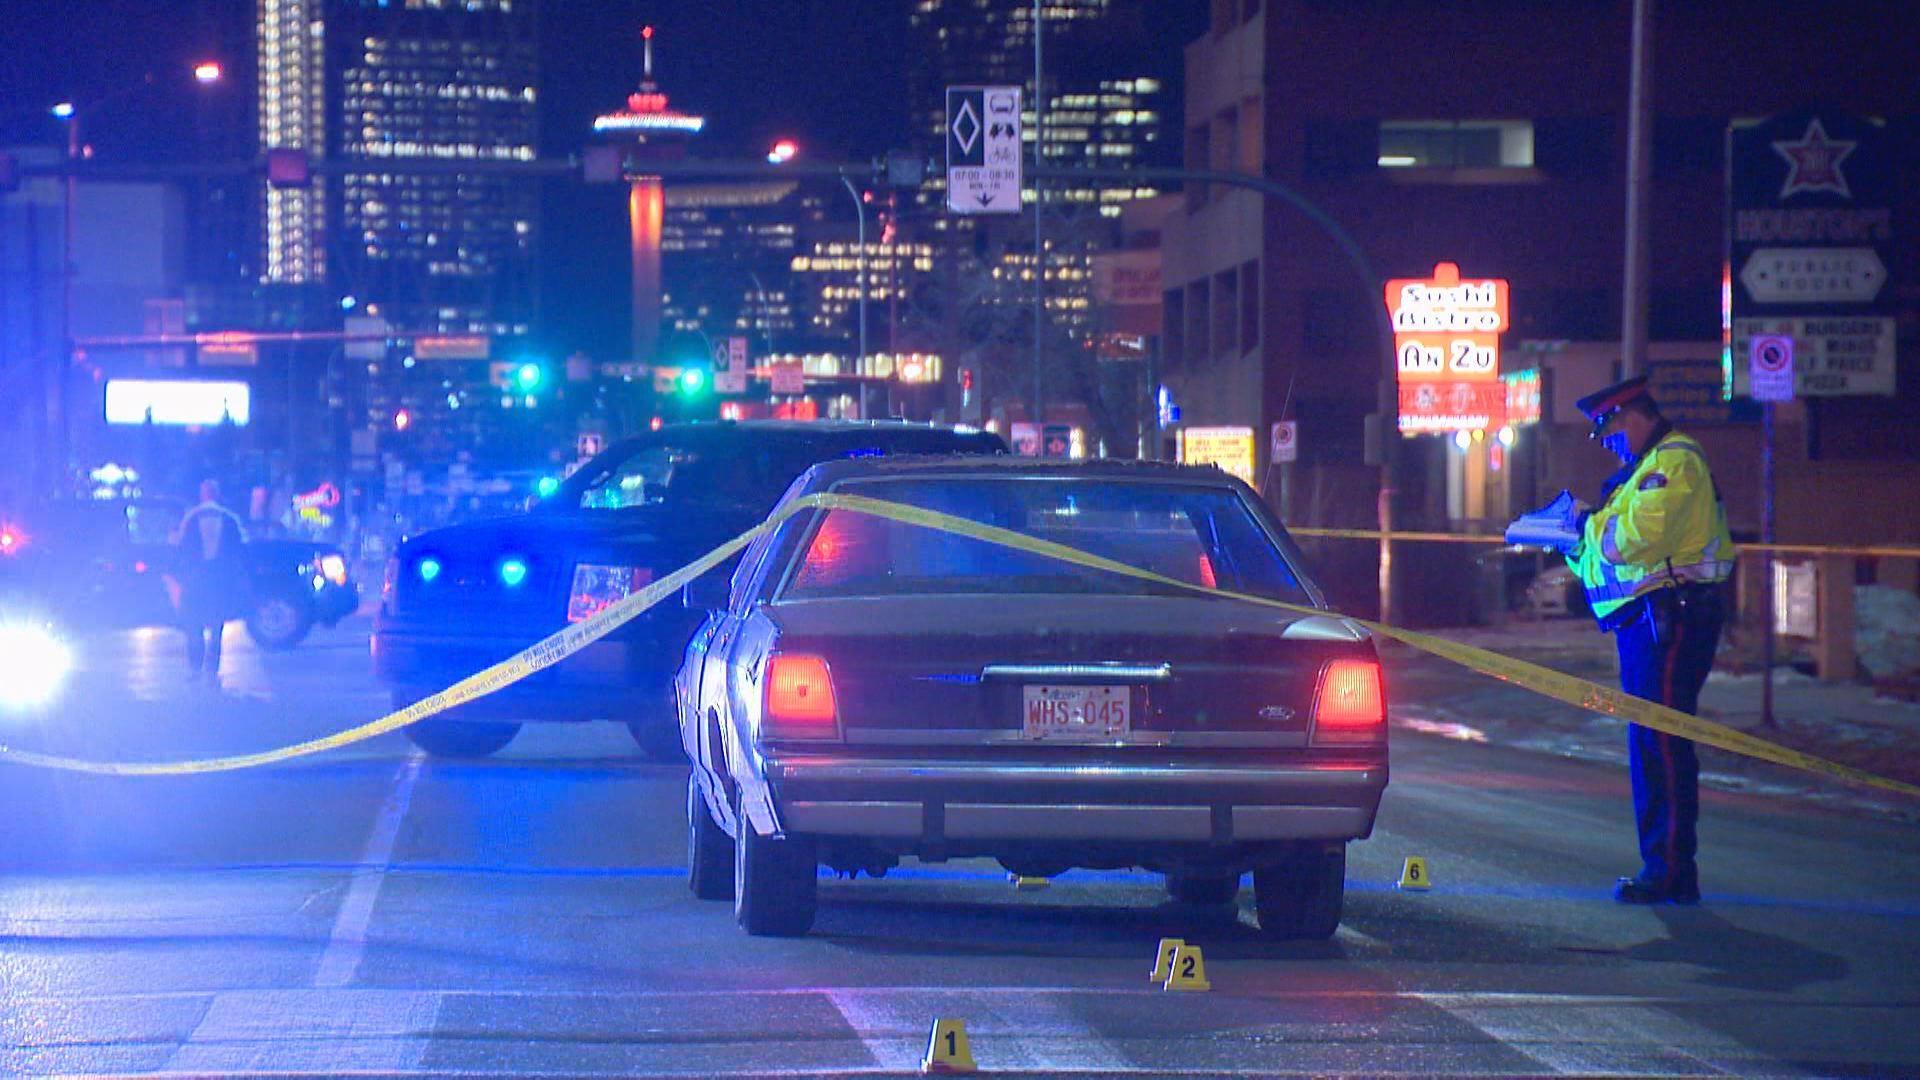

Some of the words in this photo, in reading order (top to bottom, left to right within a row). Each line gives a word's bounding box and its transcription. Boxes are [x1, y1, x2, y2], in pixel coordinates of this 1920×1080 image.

[1405, 283, 1493, 303] Sushi
[1398, 311, 1496, 327] Bistro
[1410, 863, 1420, 880] 6
[1182, 955, 1196, 978] 2
[945, 1031, 956, 1056] 1
